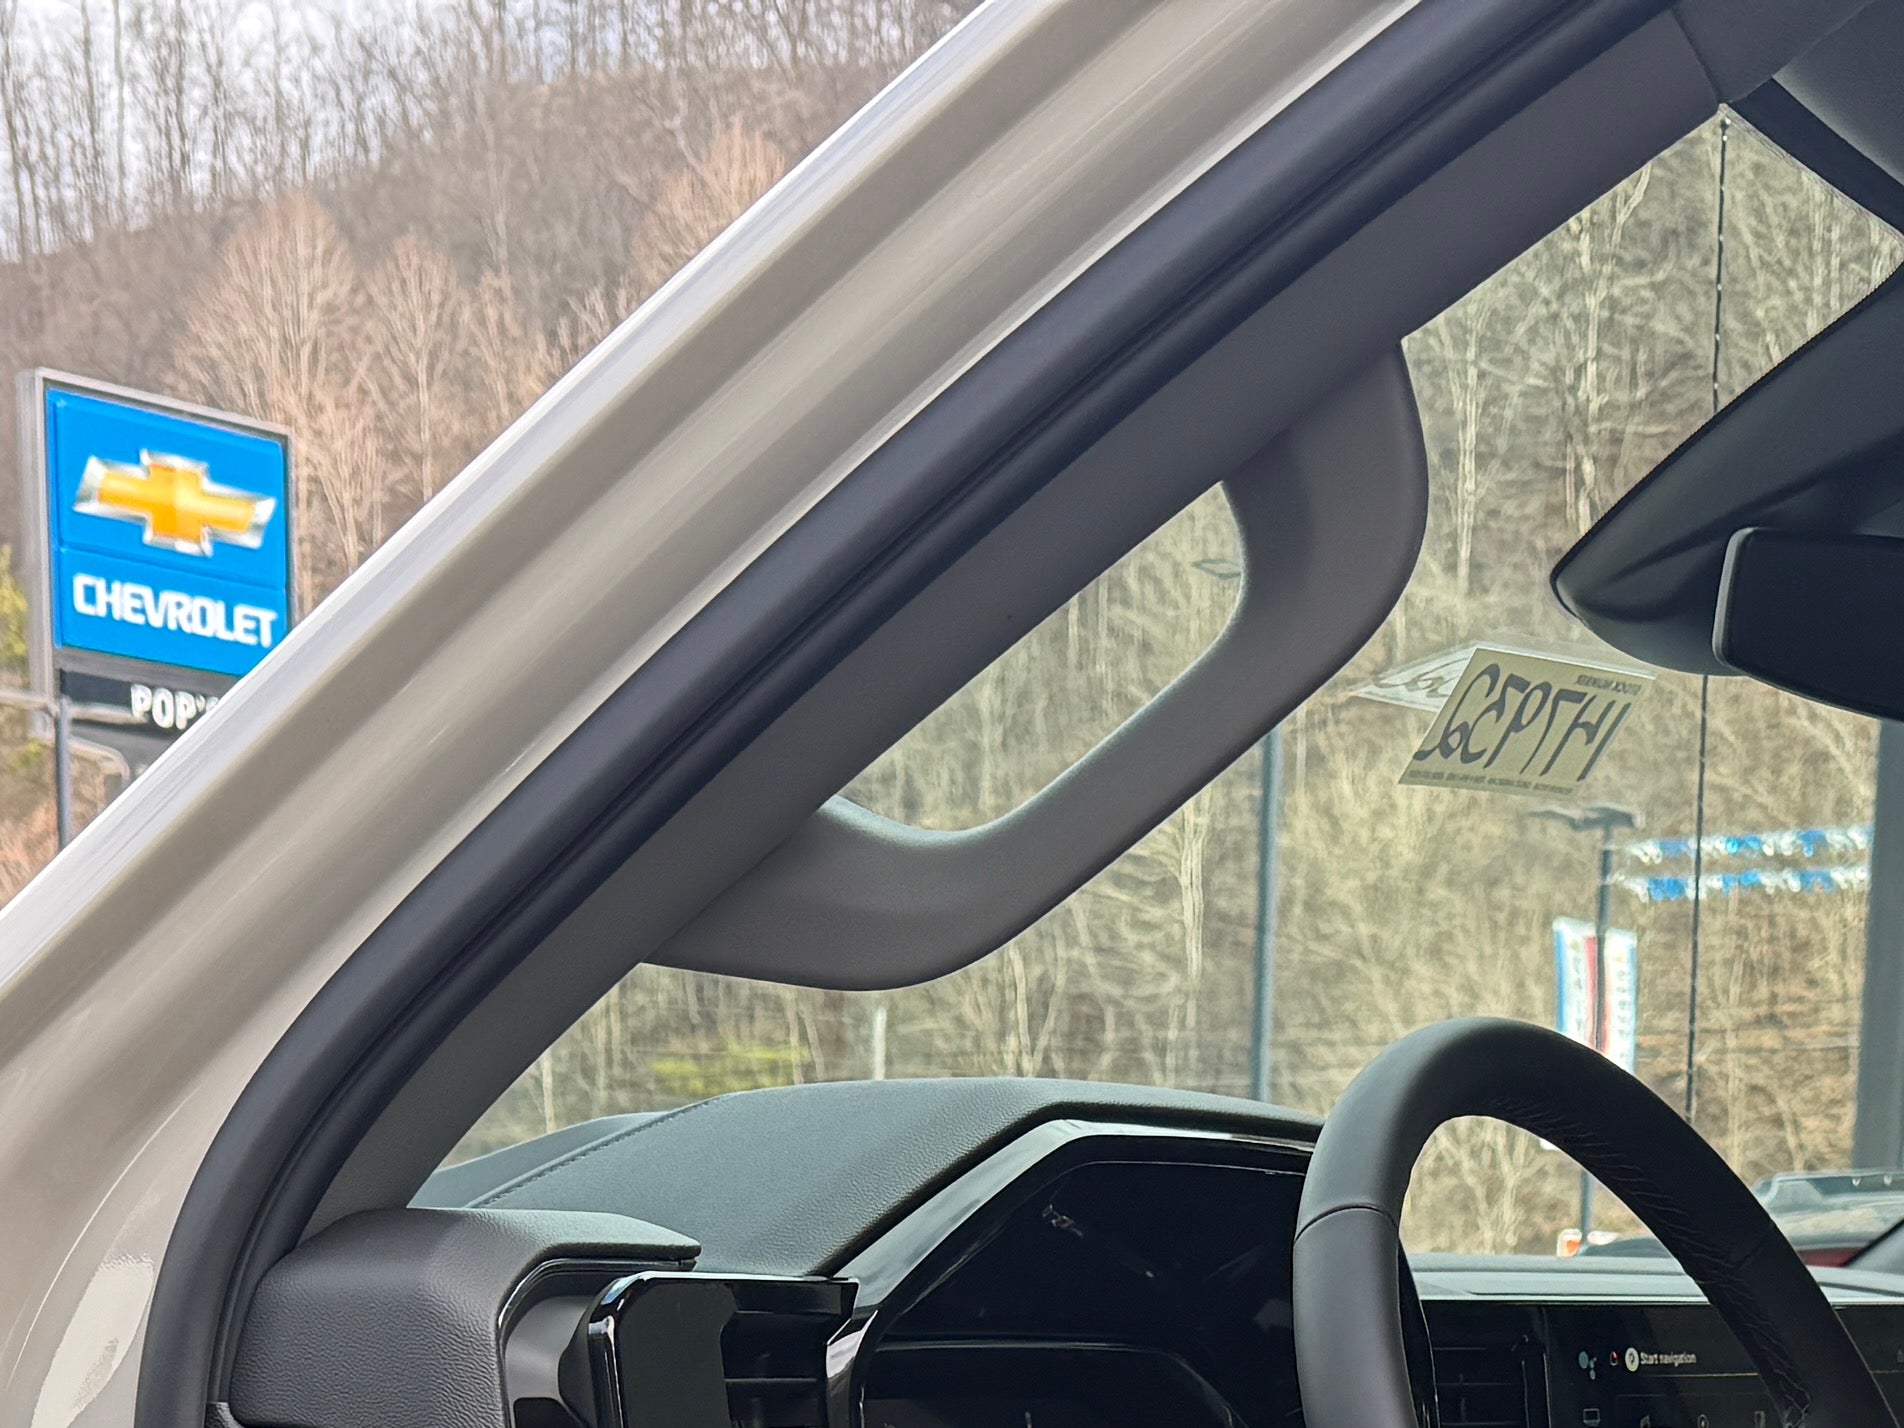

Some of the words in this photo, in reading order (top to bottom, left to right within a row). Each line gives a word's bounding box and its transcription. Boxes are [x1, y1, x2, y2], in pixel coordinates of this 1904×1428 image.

[73, 573, 278, 648] CHEVROLET
[1640, 1351, 1658, 1365] Start
[1659, 1350, 1697, 1367] navigation
